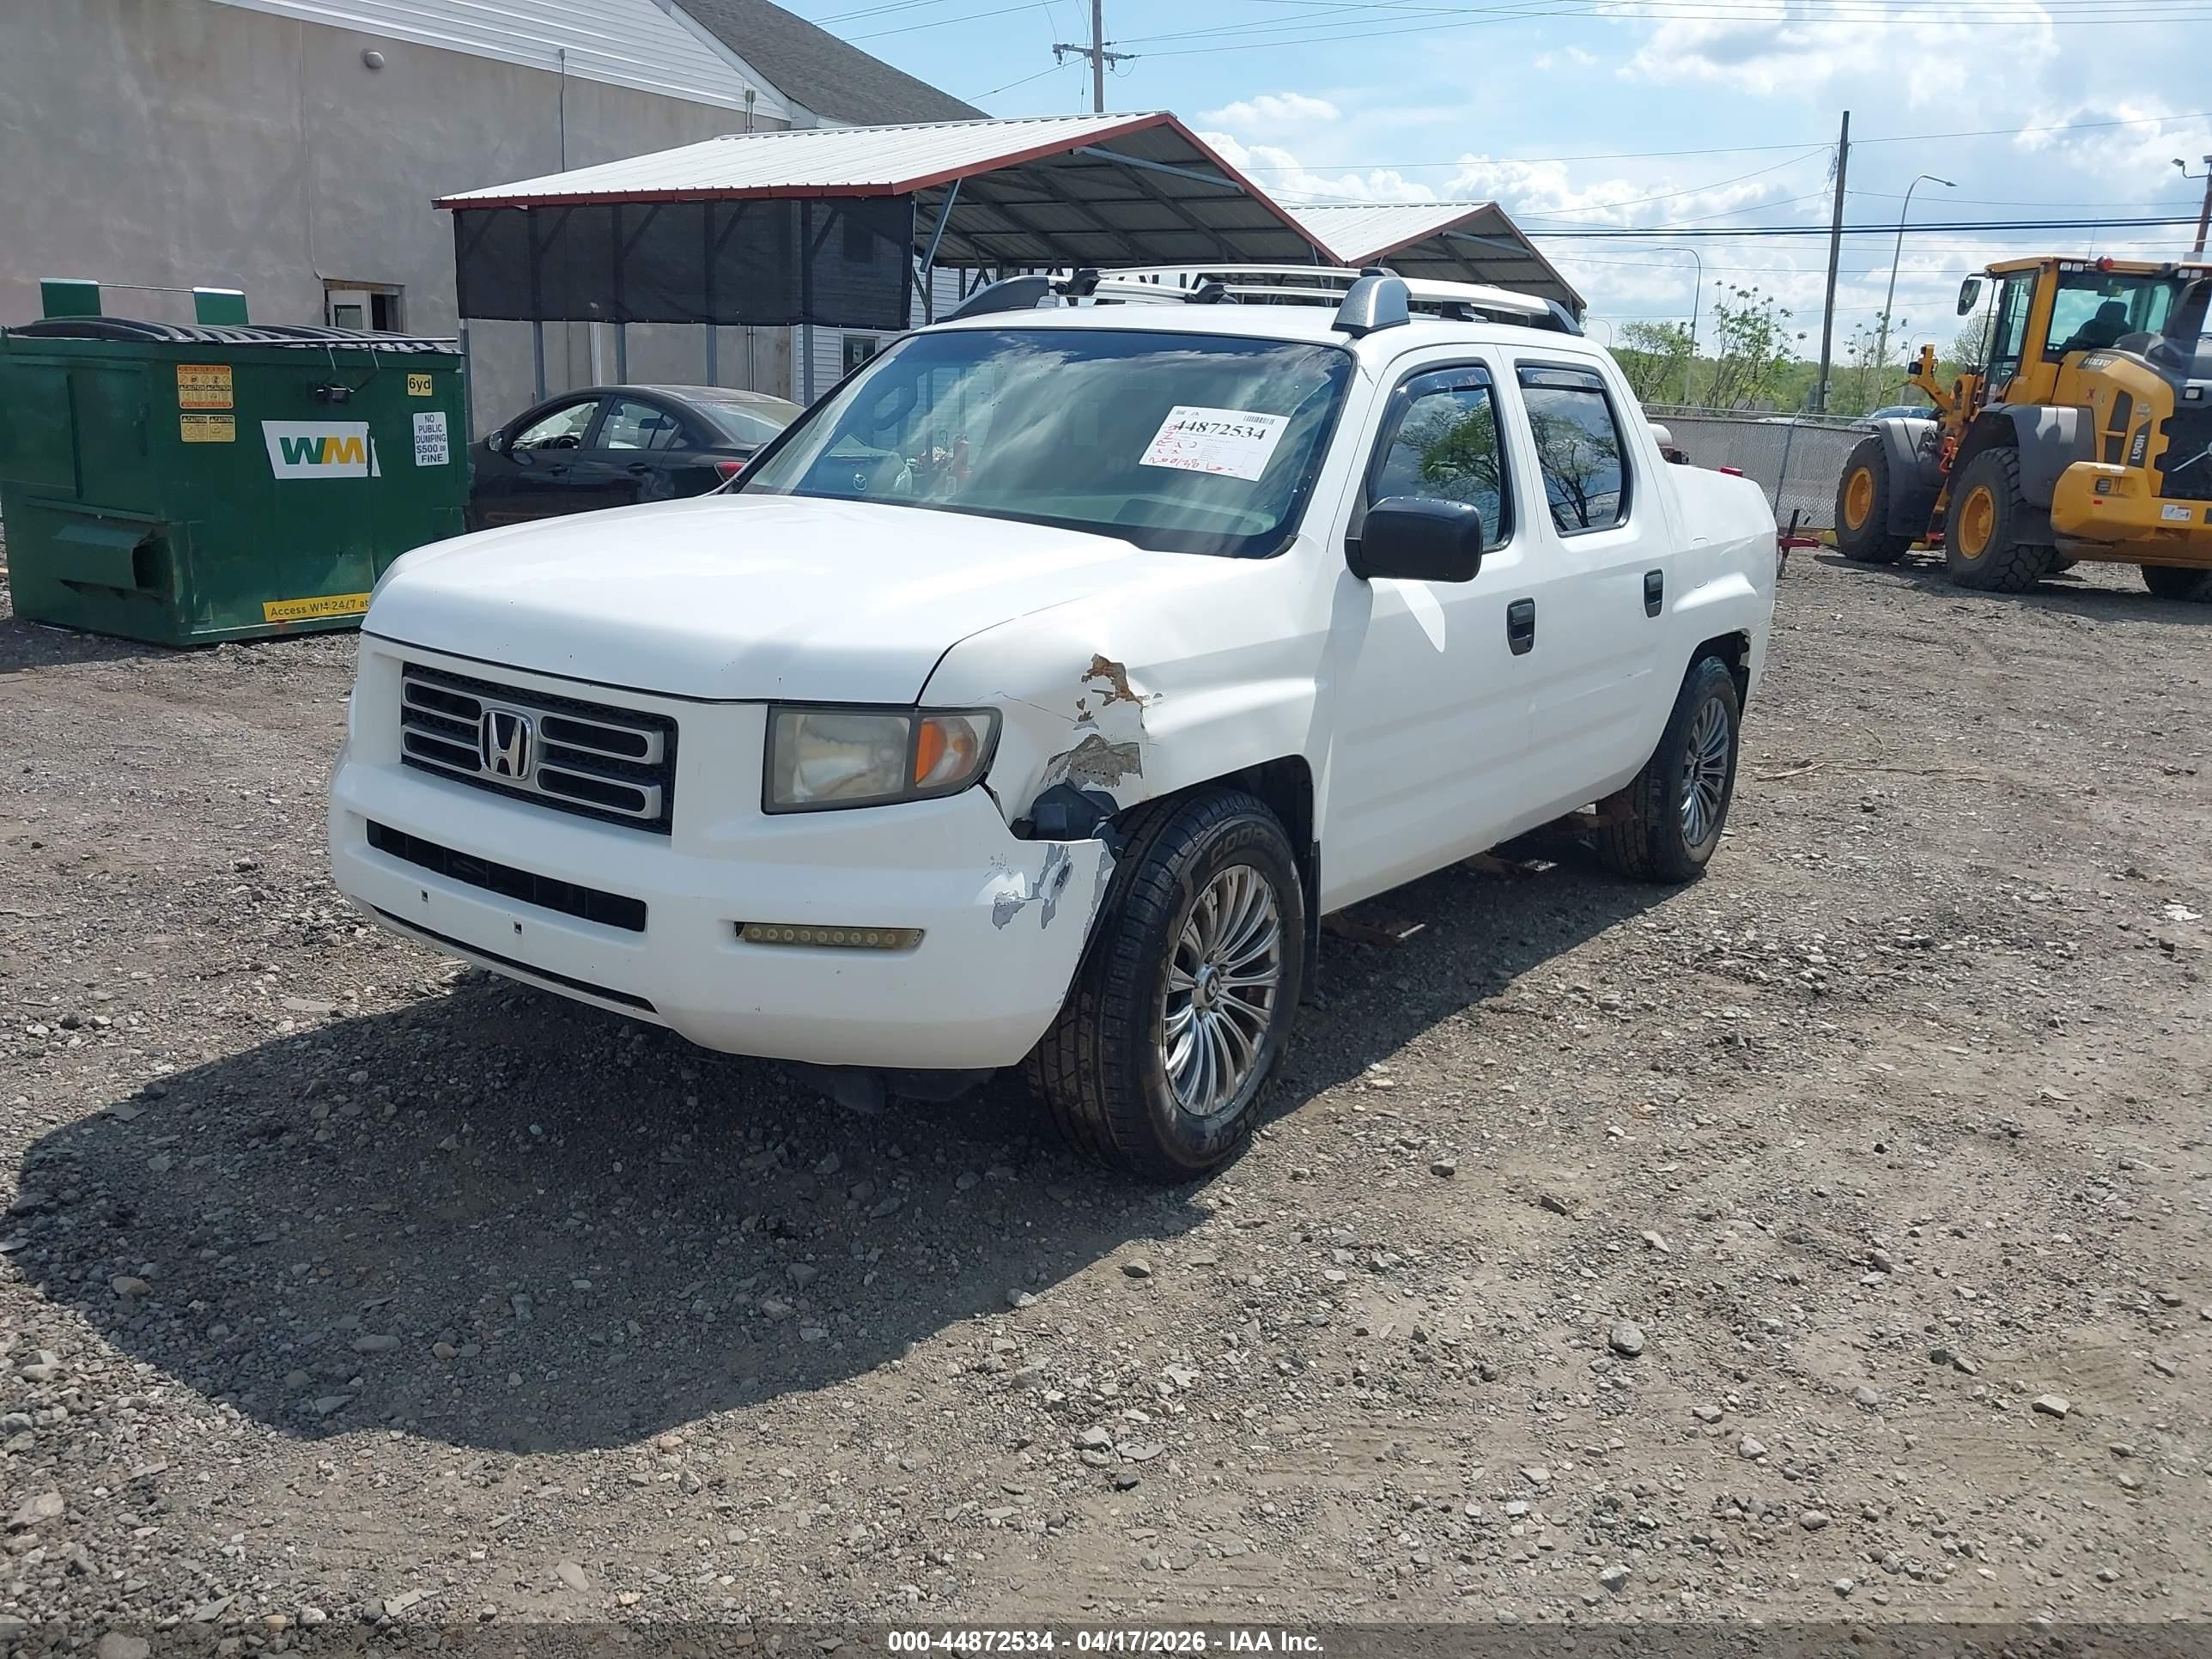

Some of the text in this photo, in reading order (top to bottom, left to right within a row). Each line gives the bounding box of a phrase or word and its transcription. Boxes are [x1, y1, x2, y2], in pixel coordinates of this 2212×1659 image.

[409, 378, 430, 392] 6yd
[424, 414, 435, 423] NO
[418, 424, 443, 434] PUBLIC
[1175, 420, 1267, 441] 44872534
[416, 434, 447, 444] DUMPING
[279, 437, 365, 465] WM
[2131, 434, 2146, 460] L90H
[421, 453, 444, 464] FINE
[270, 605, 307, 617] Access
[331, 599, 356, 611] 24/7
